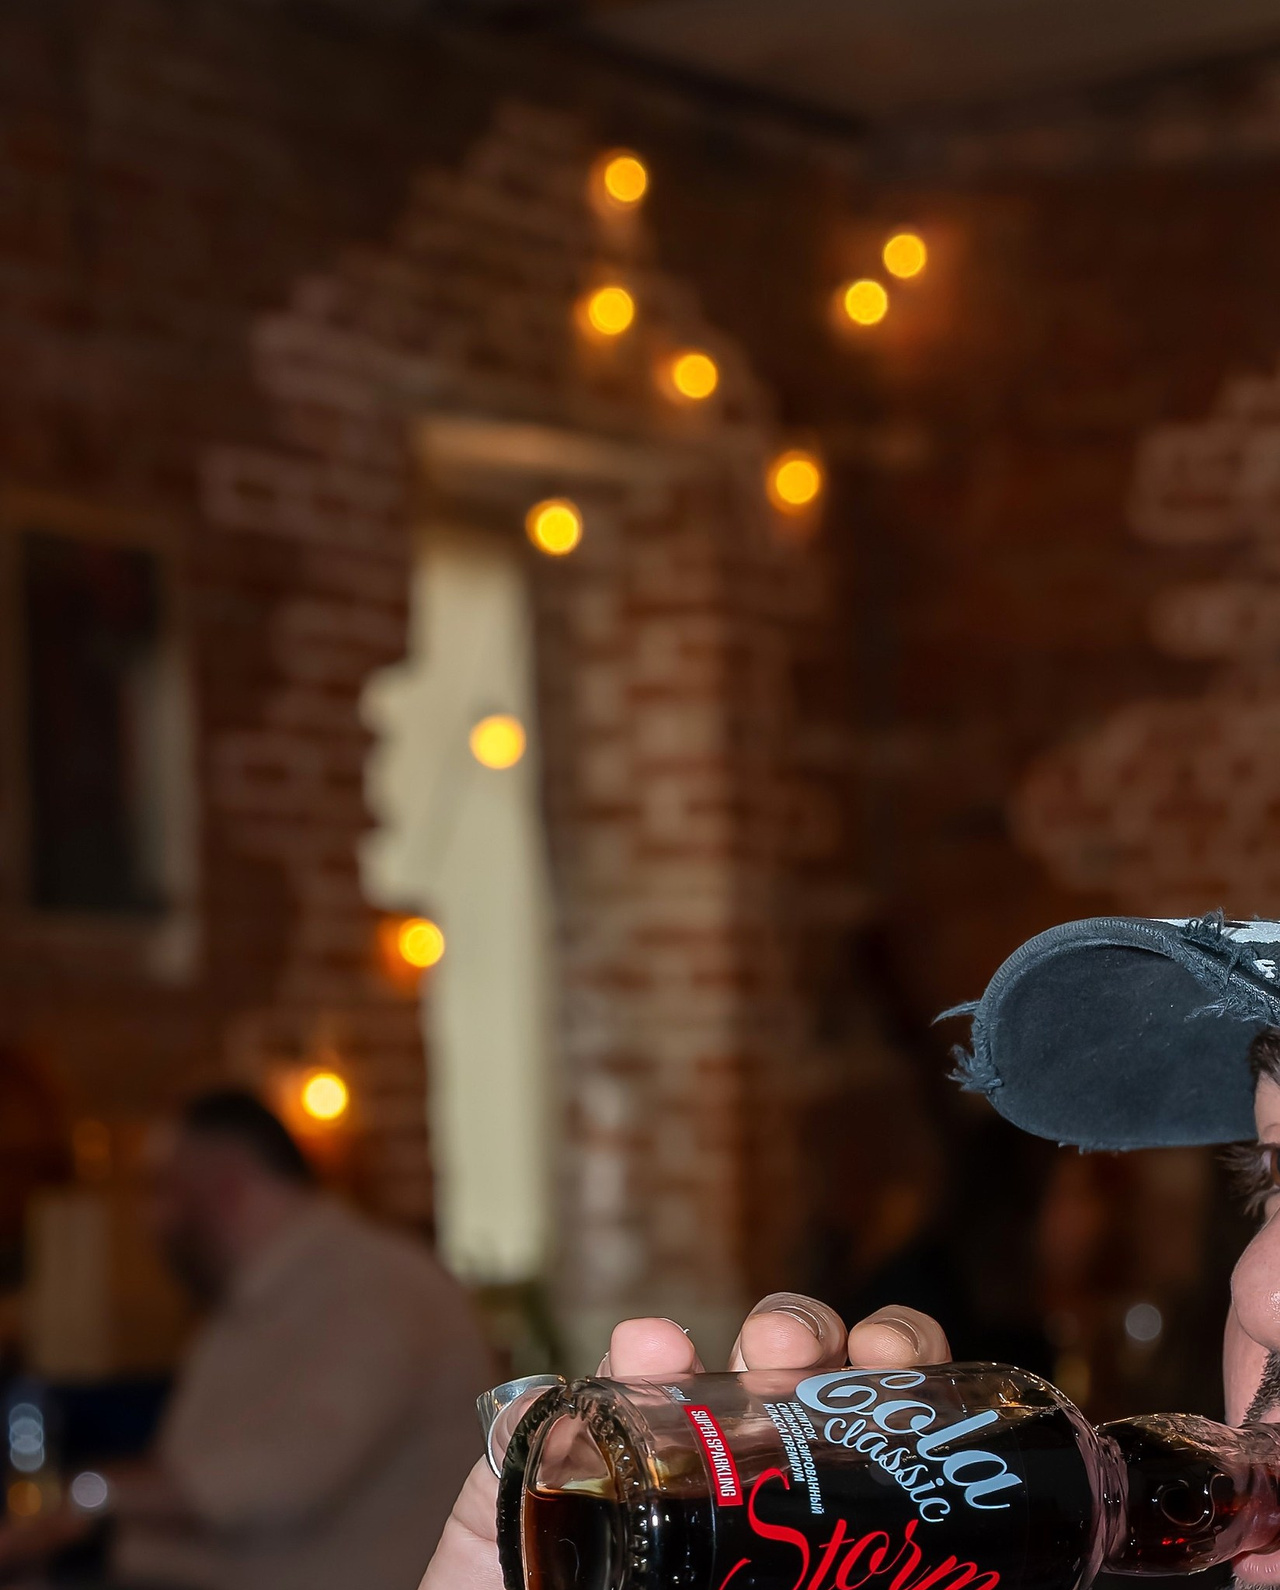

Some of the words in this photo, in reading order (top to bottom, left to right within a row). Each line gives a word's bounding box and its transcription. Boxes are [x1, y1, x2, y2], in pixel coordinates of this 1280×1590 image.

[690, 1410, 718, 1438] SUPER
[708, 1437, 737, 1497] SPARKLING
[763, 1403, 789, 1433] КЛАССА
[781, 1433, 806, 1482] ПРЕМИУМ
[776, 1402, 825, 1514] СИЛЬНОГАЗИРОВАННЫЙ
[788, 1401, 818, 1440] НАПИТОК
[795, 1370, 1023, 1509] Cola
[824, 1417, 950, 1522] Classic
